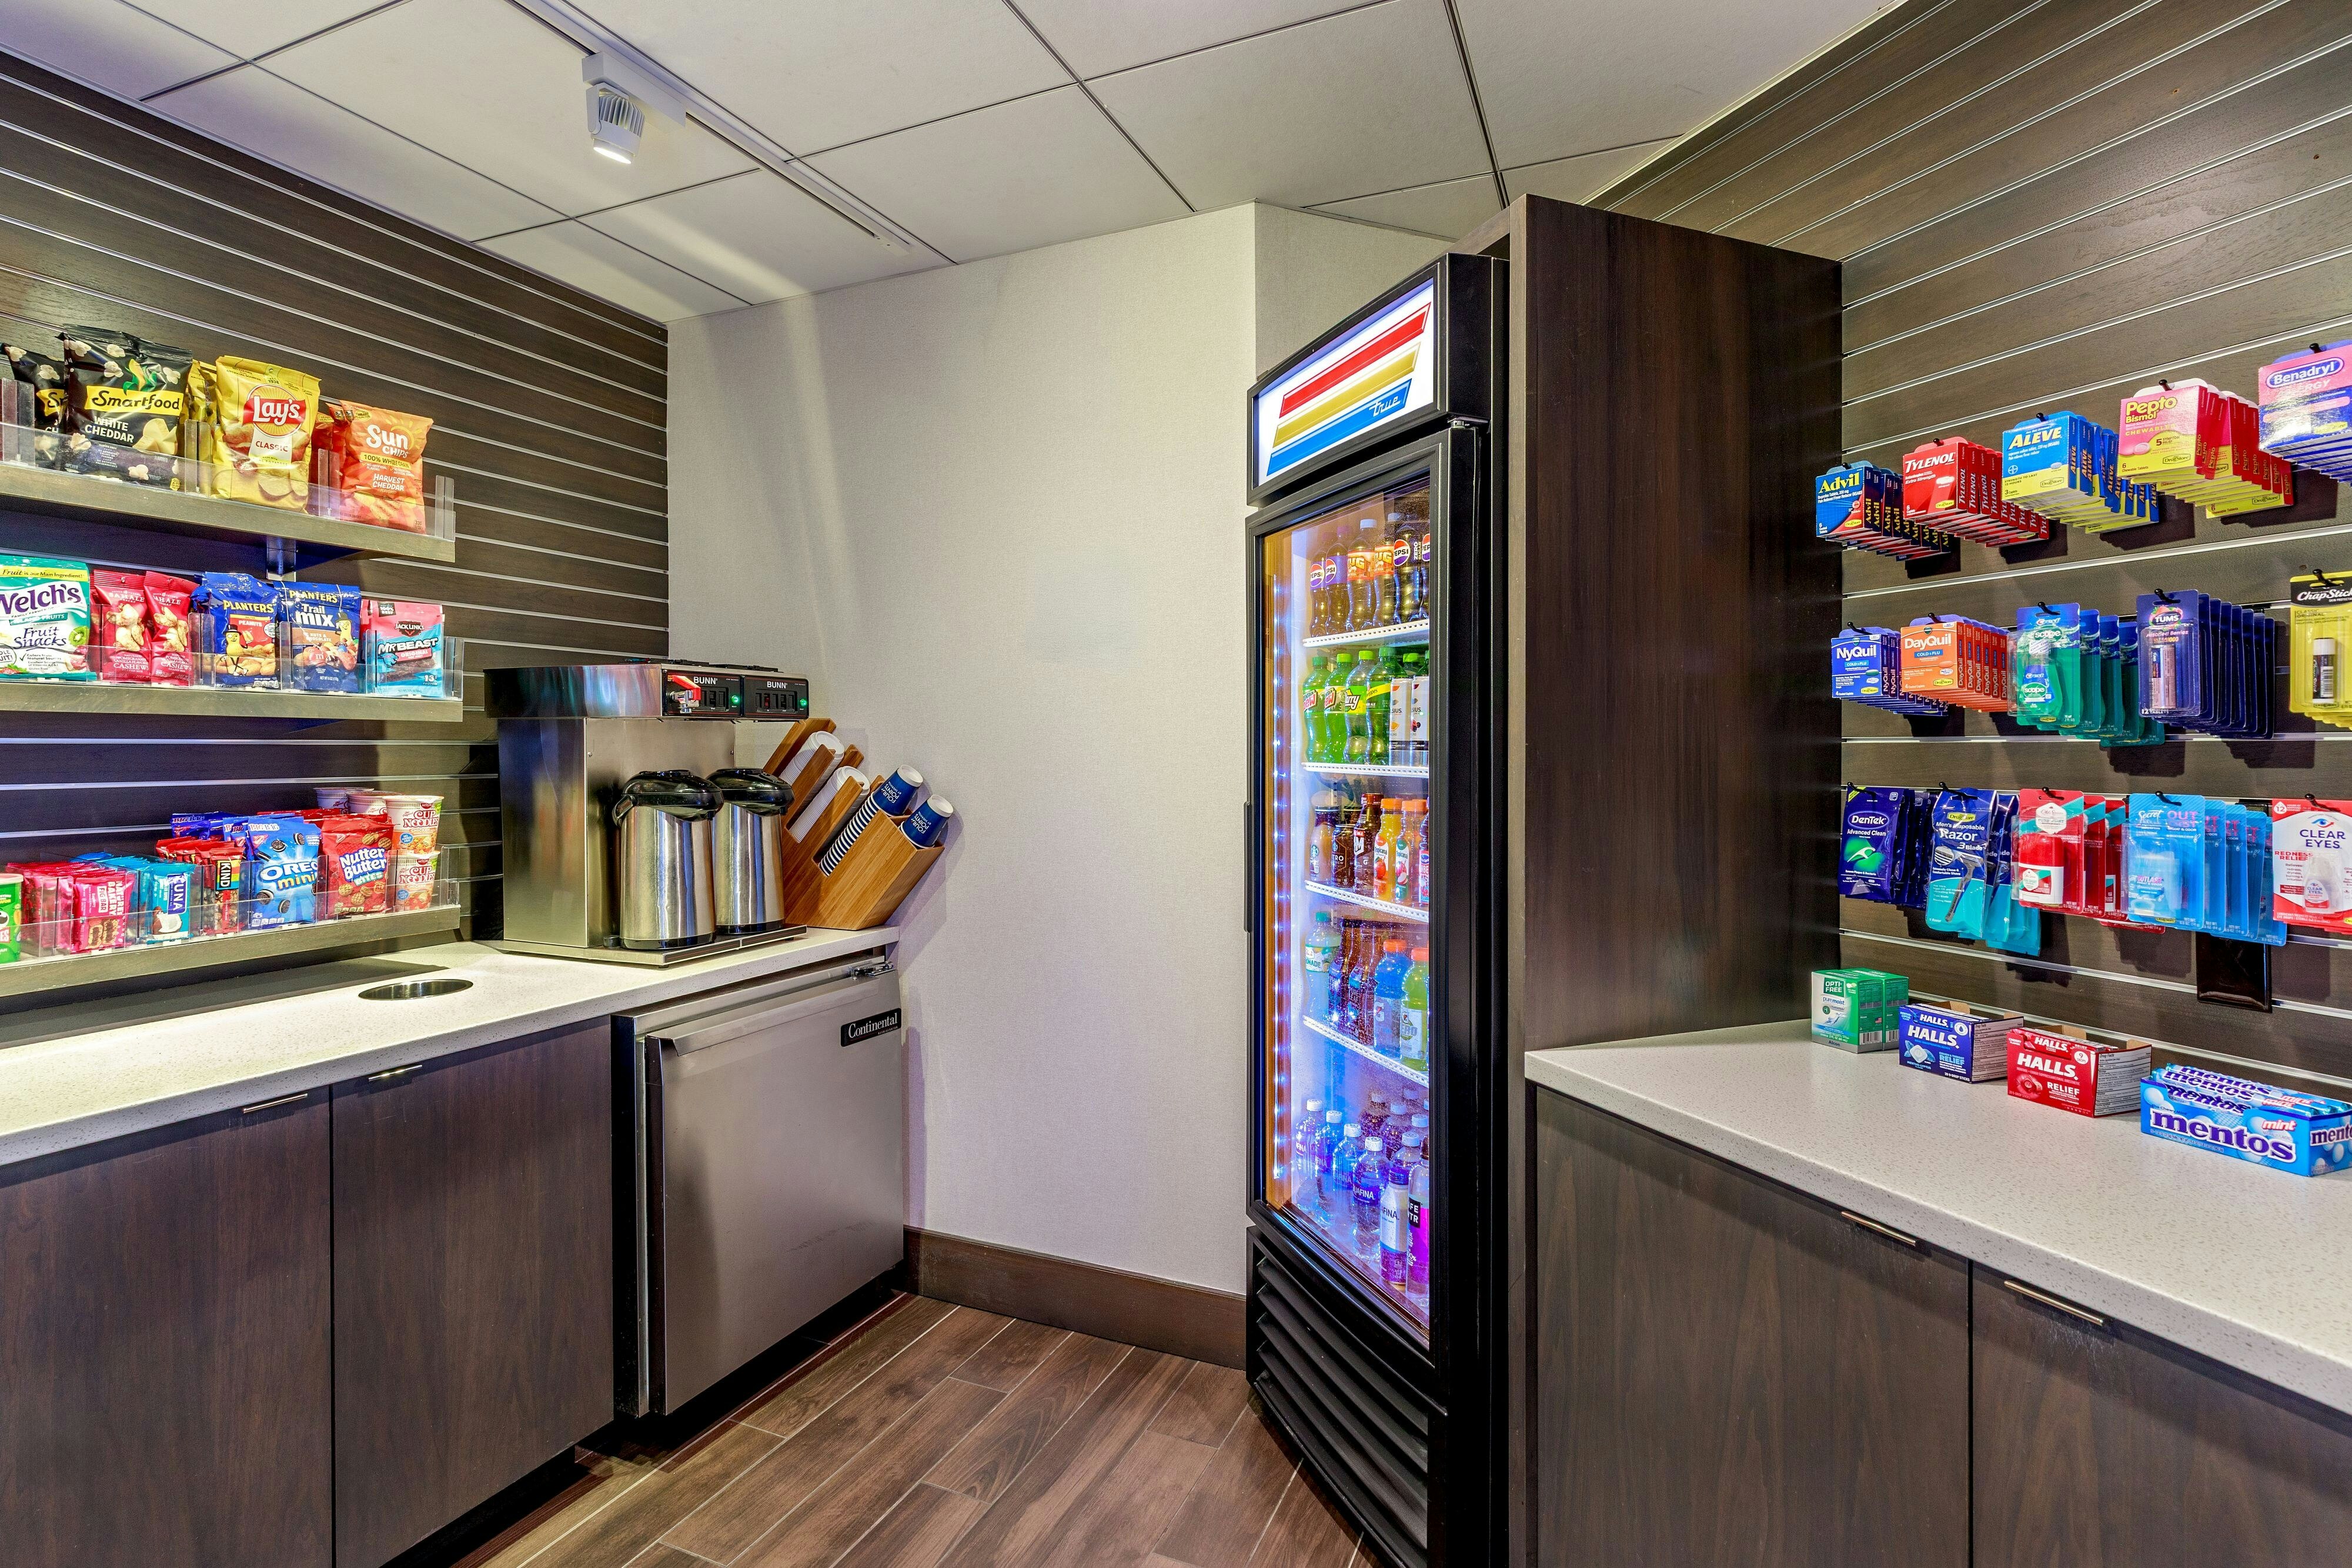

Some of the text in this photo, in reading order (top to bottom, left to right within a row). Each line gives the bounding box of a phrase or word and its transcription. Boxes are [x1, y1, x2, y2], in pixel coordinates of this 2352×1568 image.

[2273, 361, 2335, 386] Benadryl
[92, 390, 180, 410] Smartfood
[1369, 396, 1401, 417] true
[2126, 396, 2177, 416] Pepto
[253, 396, 300, 426] Lay's
[2125, 411, 2157, 424] Bismol
[94, 416, 129, 432] WHITE
[2125, 423, 2176, 436] CHEWABLES
[85, 424, 135, 443] CHEDDAR
[366, 424, 409, 450] Sun
[2008, 427, 2062, 450] ALEVE
[256, 441, 288, 452] CLASSIC
[382, 446, 409, 459] CHIPS
[364, 454, 381, 463] 100%
[1905, 452, 1955, 473] TYLENOL
[373, 474, 405, 484] HARVEST
[1818, 473, 1860, 494] Advil
[372, 481, 405, 492] CHEDDAR
[108, 593, 145, 602] SAHALE
[289, 590, 338, 603] PLANTERS
[223, 600, 274, 613] PLANTERS
[302, 604, 325, 614] Trail
[296, 611, 335, 627] mix
[24, 627, 59, 638] Fruit
[2034, 631, 2061, 639] scope
[14, 636, 66, 649] Snacks
[1905, 634, 1952, 650] DayQuil
[400, 650, 429, 658] ORIGINAL
[1836, 645, 1876, 661] NyQuil
[161, 661, 192, 671] CASHEWS
[694, 677, 716, 685] BUNN
[883, 790, 897, 803] FOUR
[884, 784, 900, 800] POINTS
[413, 811, 436, 819] CUP
[1852, 815, 1885, 824] DenTek
[2138, 810, 2163, 820] Secret
[403, 818, 439, 828] NOODLES
[913, 820, 926, 834] FOUR
[914, 814, 929, 830] POINTS
[1939, 828, 1977, 842] Razor
[2300, 829, 2346, 839] CLEAR
[2306, 840, 2340, 848] EYES
[339, 847, 386, 868] Nutter
[220, 862, 231, 887] KIND
[346, 858, 387, 881] Butter
[354, 872, 383, 886] BITES
[400, 874, 434, 884] NOODLES
[99, 899, 108, 911] BAR
[1823, 997, 1845, 1005] puremoist
[848, 1012, 898, 1039] Continental
[1920, 1014, 1947, 1026] HALLS
[1908, 1025, 1957, 1047] HALLS
[2034, 1037, 2067, 1051] HALLS
[1940, 1055, 1965, 1065] RELIEF
[2017, 1053, 2078, 1078] HALLS
[2047, 1081, 2080, 1095] RELIEF
[2164, 1071, 2257, 1101] mentos
[2166, 1084, 2252, 1114] mentos
[2263, 1119, 2297, 1131] mint
[2150, 1108, 2296, 1163] mentos
